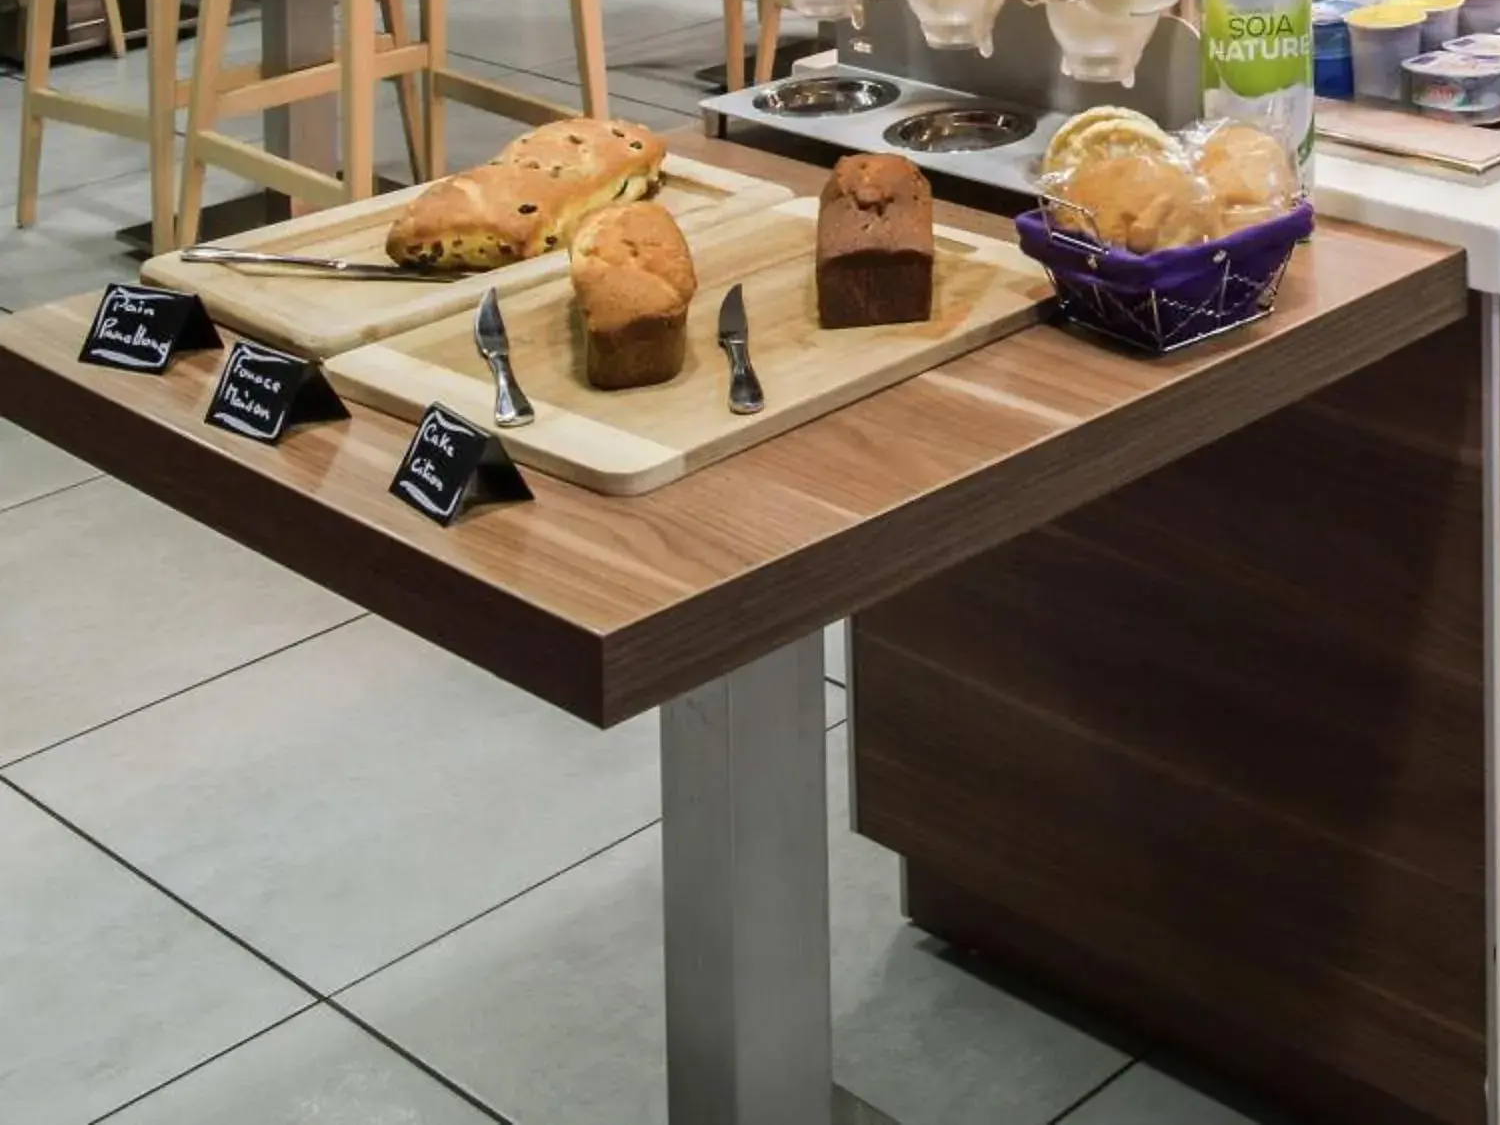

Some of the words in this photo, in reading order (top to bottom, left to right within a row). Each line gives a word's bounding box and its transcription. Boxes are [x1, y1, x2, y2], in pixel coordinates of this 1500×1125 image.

[1229, 14, 1294, 39] SOJA
[1209, 35, 1311, 61] NATURE
[111, 295, 155, 316] Pain
[422, 422, 456, 458] Cake
